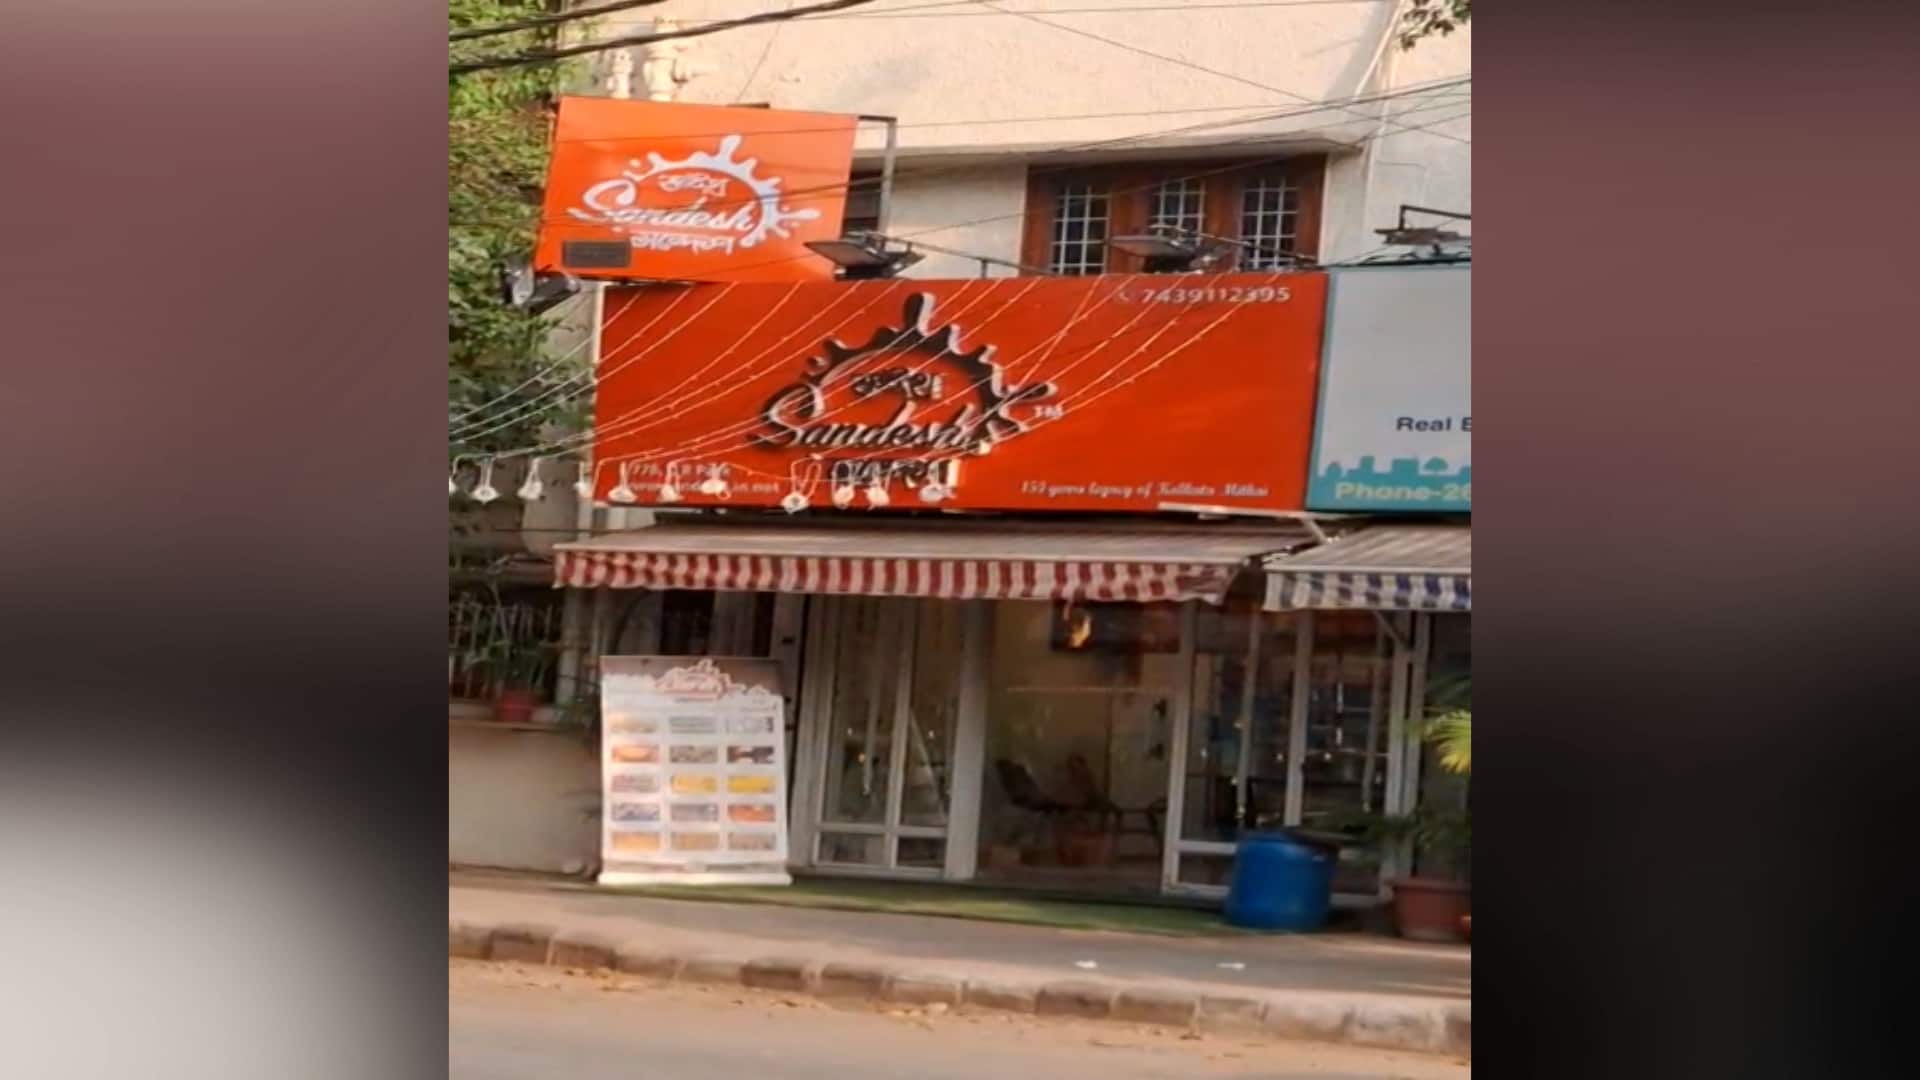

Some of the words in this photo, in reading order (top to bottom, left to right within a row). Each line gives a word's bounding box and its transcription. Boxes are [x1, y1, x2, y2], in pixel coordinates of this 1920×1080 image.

[567, 178, 757, 231] Sandesh
[752, 384, 980, 451] Sandesh
[1396, 416, 1451, 431] Real
[1136, 481, 1153, 498] of
